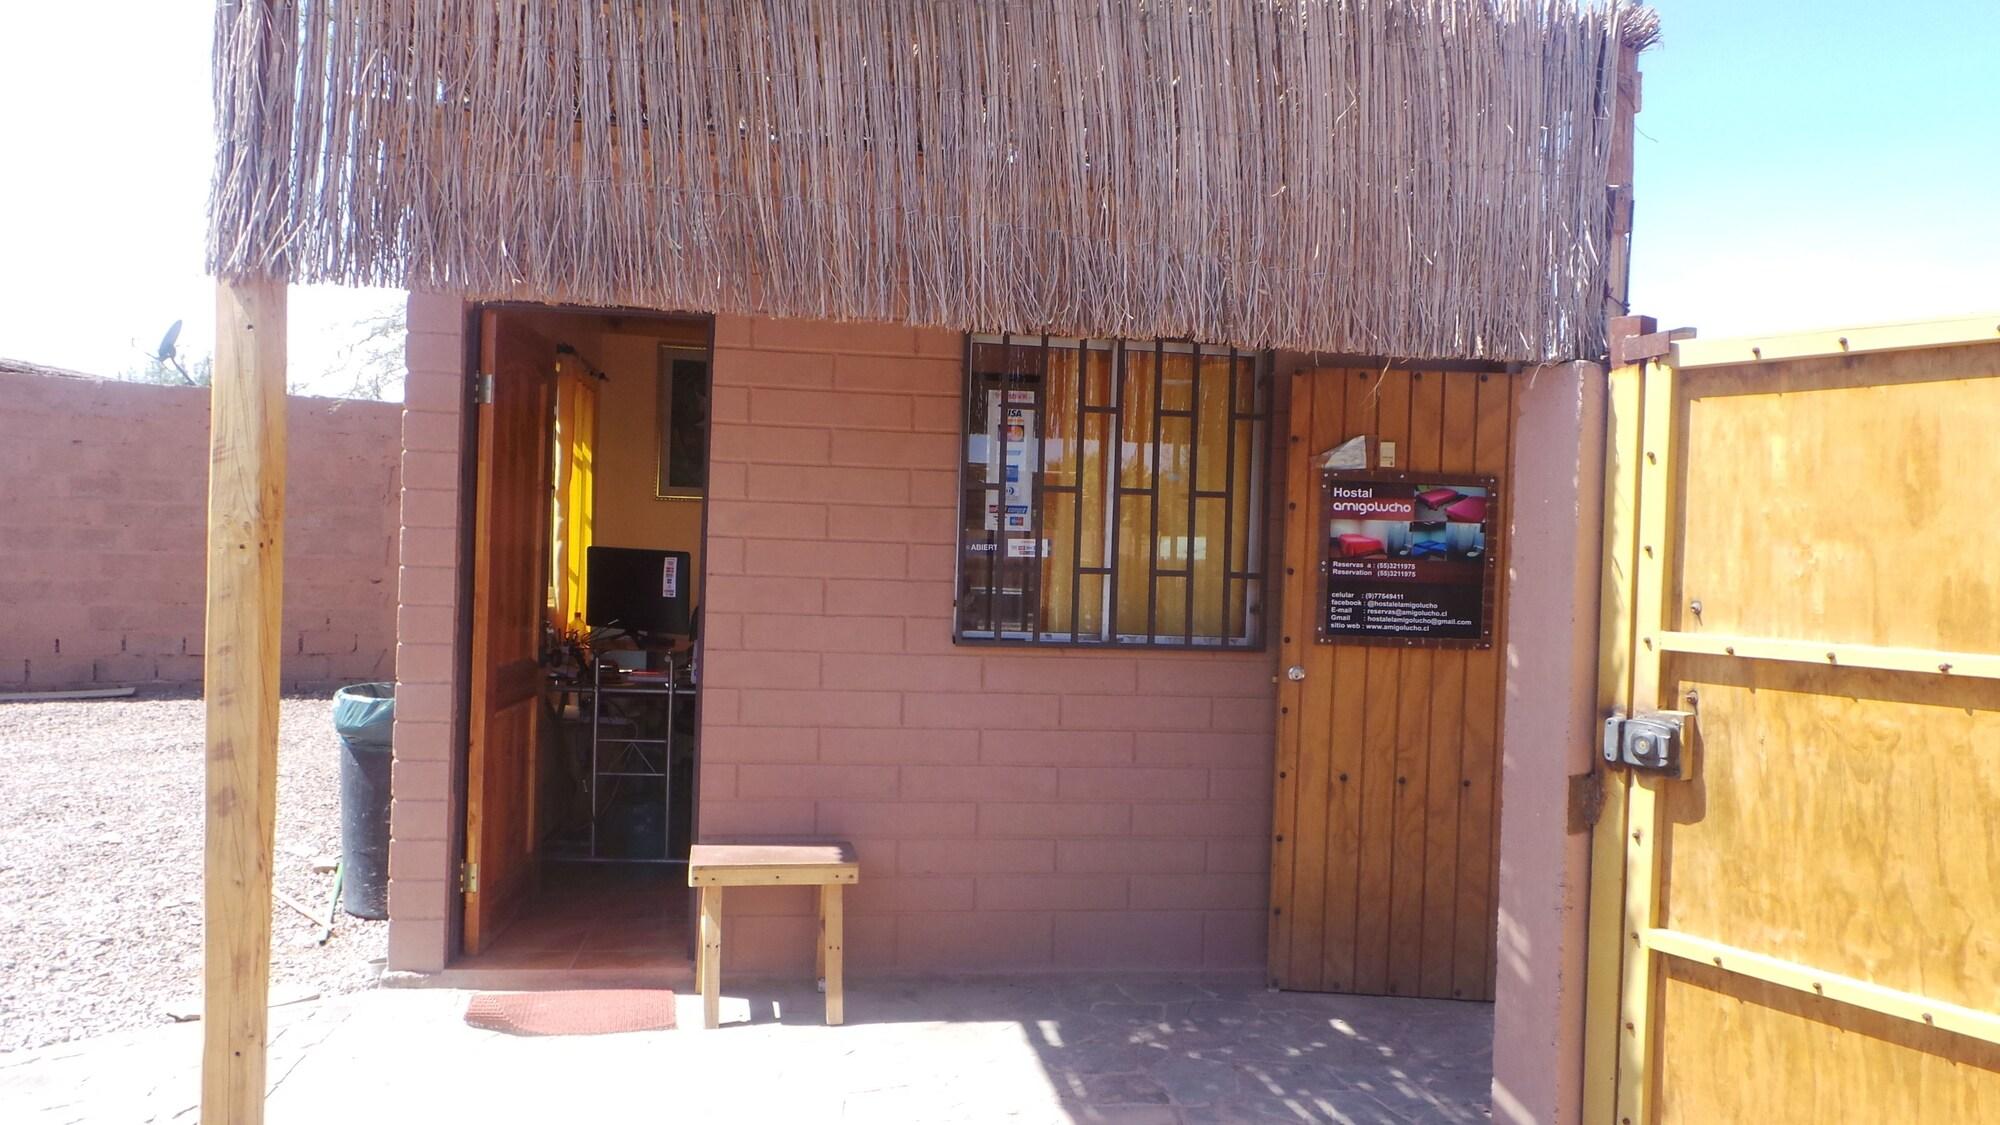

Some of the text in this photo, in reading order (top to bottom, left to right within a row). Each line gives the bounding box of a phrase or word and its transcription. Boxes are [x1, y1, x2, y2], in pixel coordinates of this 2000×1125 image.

[1334, 488, 1372, 498] Hostal
[1333, 502, 1411, 514] amigolucho
[971, 543, 998, 552] ABIERT
